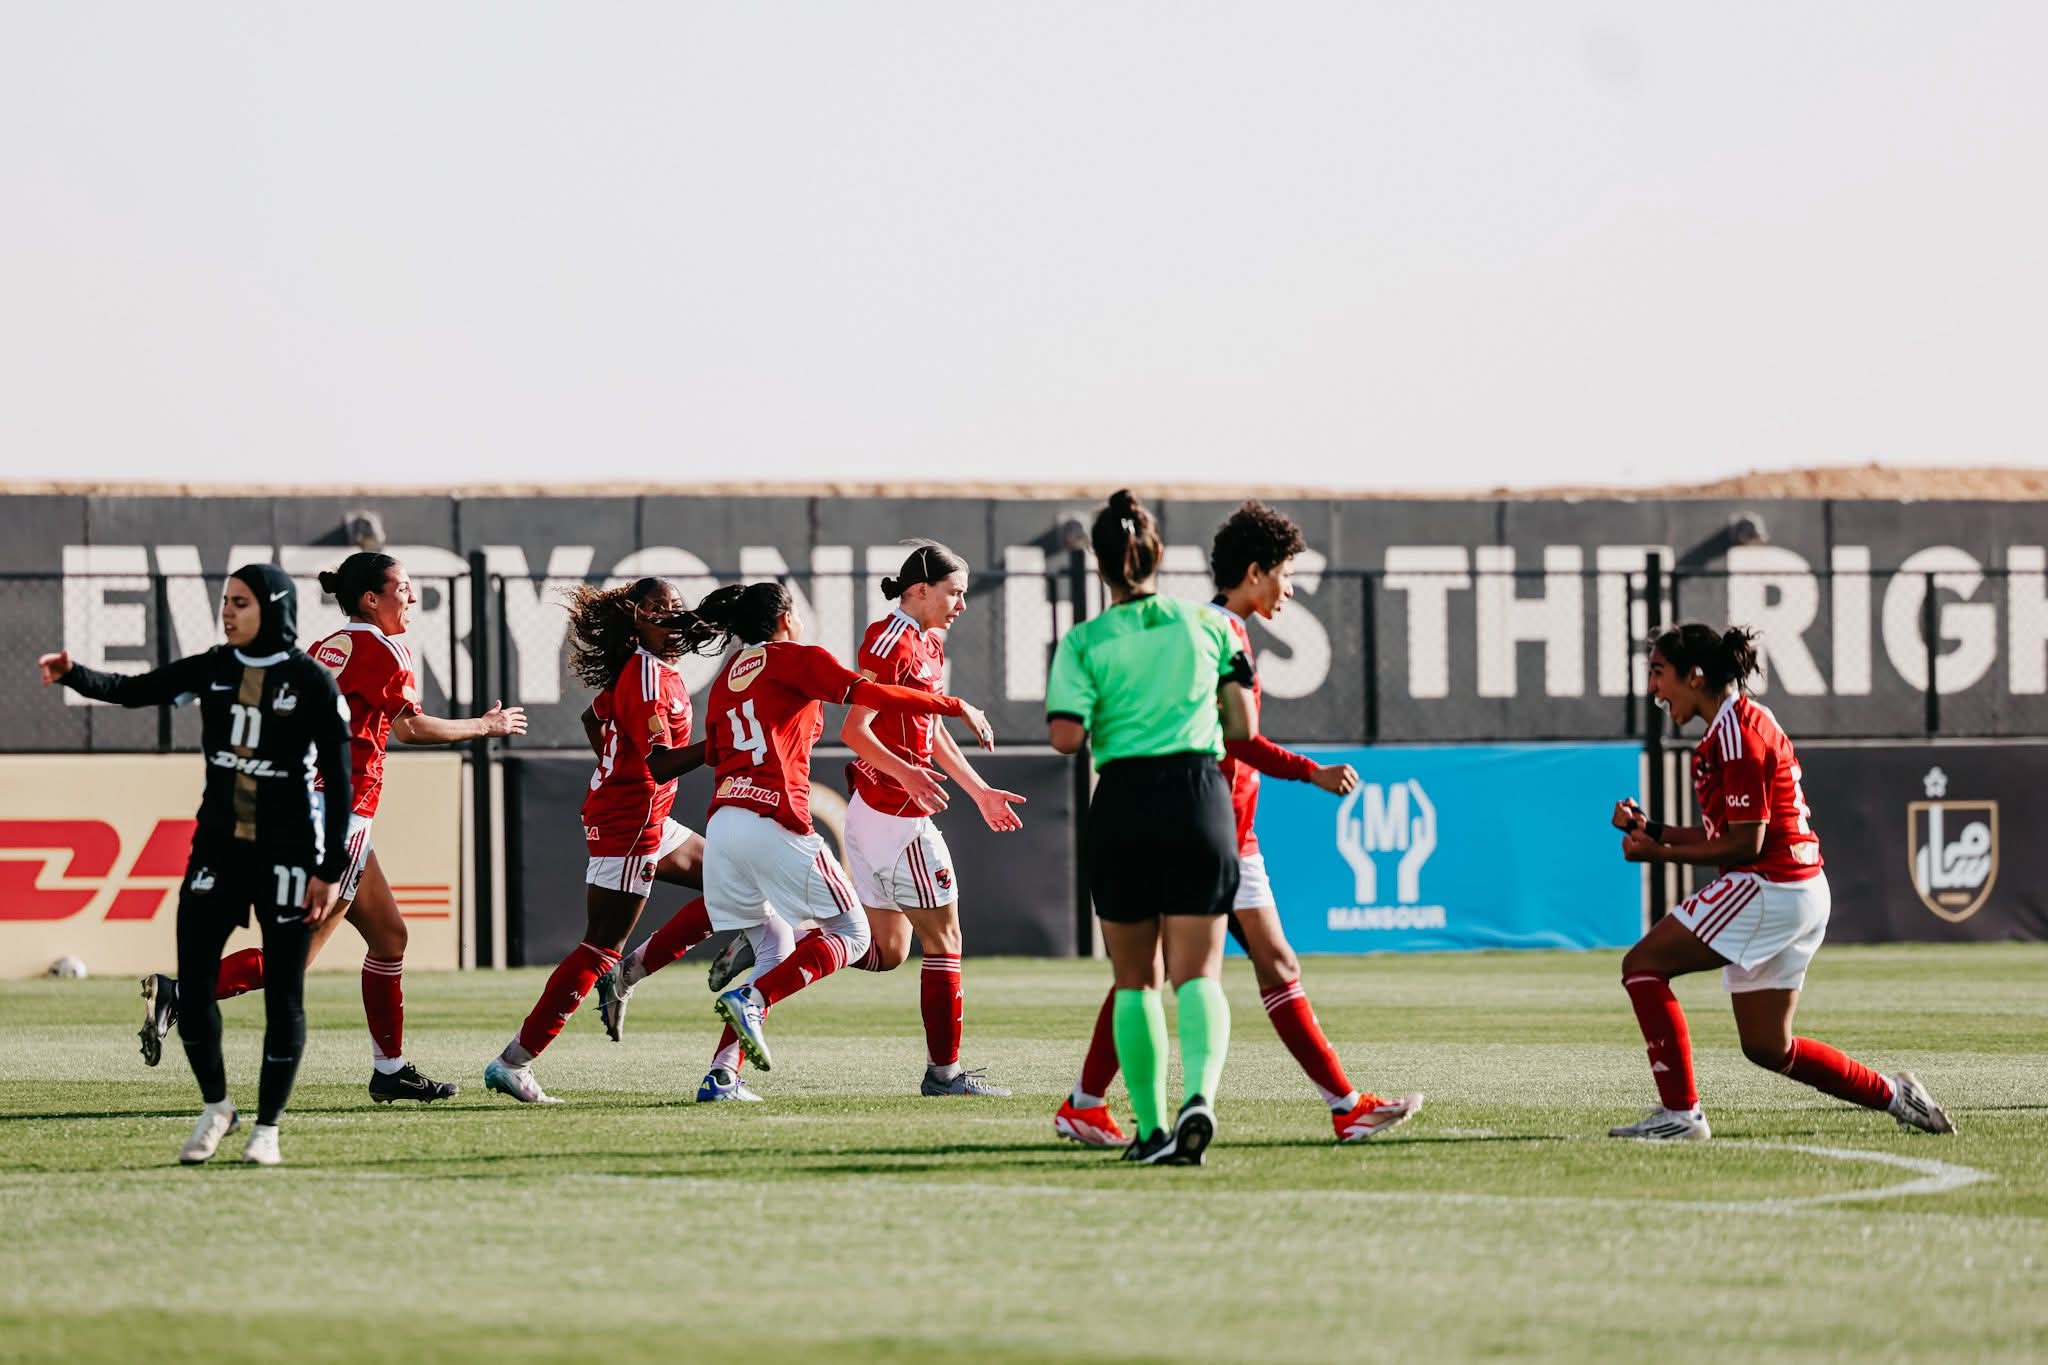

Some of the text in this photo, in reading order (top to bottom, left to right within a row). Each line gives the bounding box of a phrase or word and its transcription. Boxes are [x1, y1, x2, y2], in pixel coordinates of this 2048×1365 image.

[1383, 546, 1675, 698] THE
[320, 649, 345, 665] Lipton
[732, 658, 761, 677] Lipton
[230, 704, 262, 749] 11
[726, 698, 768, 766] 4
[210, 751, 276, 778] DHL
[273, 865, 307, 907] 11
[1327, 905, 1447, 931] MANSOUR
